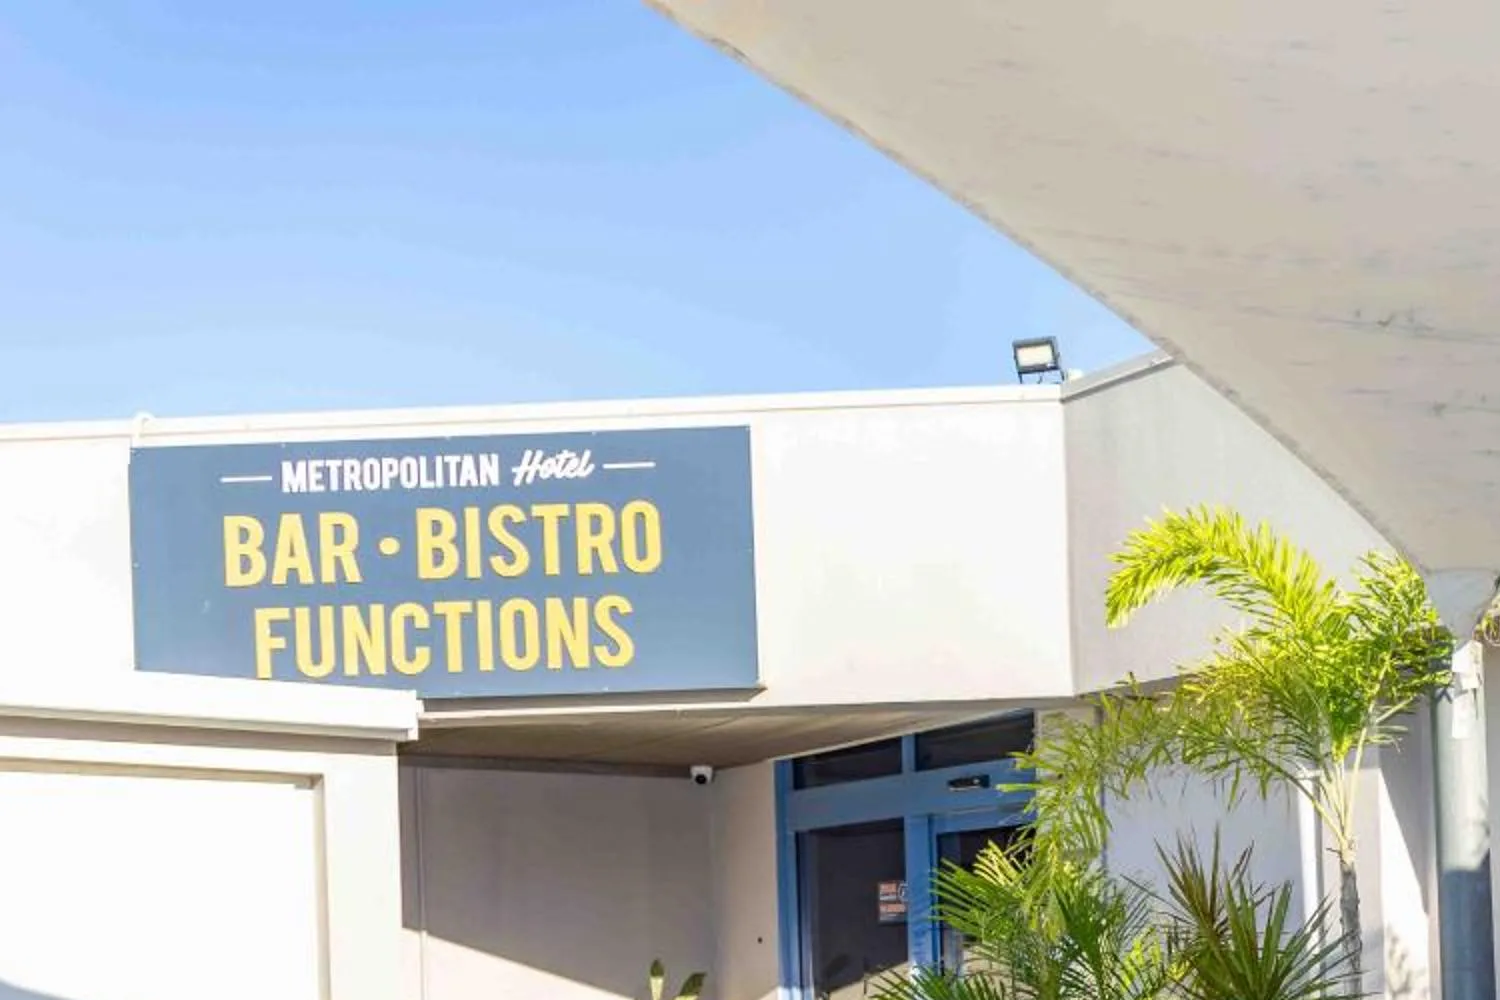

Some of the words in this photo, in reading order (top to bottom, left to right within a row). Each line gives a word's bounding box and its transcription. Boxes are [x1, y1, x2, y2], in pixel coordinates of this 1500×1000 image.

[281, 453, 499, 493] METROPOLITAN
[512, 449, 596, 486] Hotel
[223, 511, 363, 588] BAR
[416, 500, 662, 579] BISTRO
[254, 595, 635, 679] FUNCTIONS
